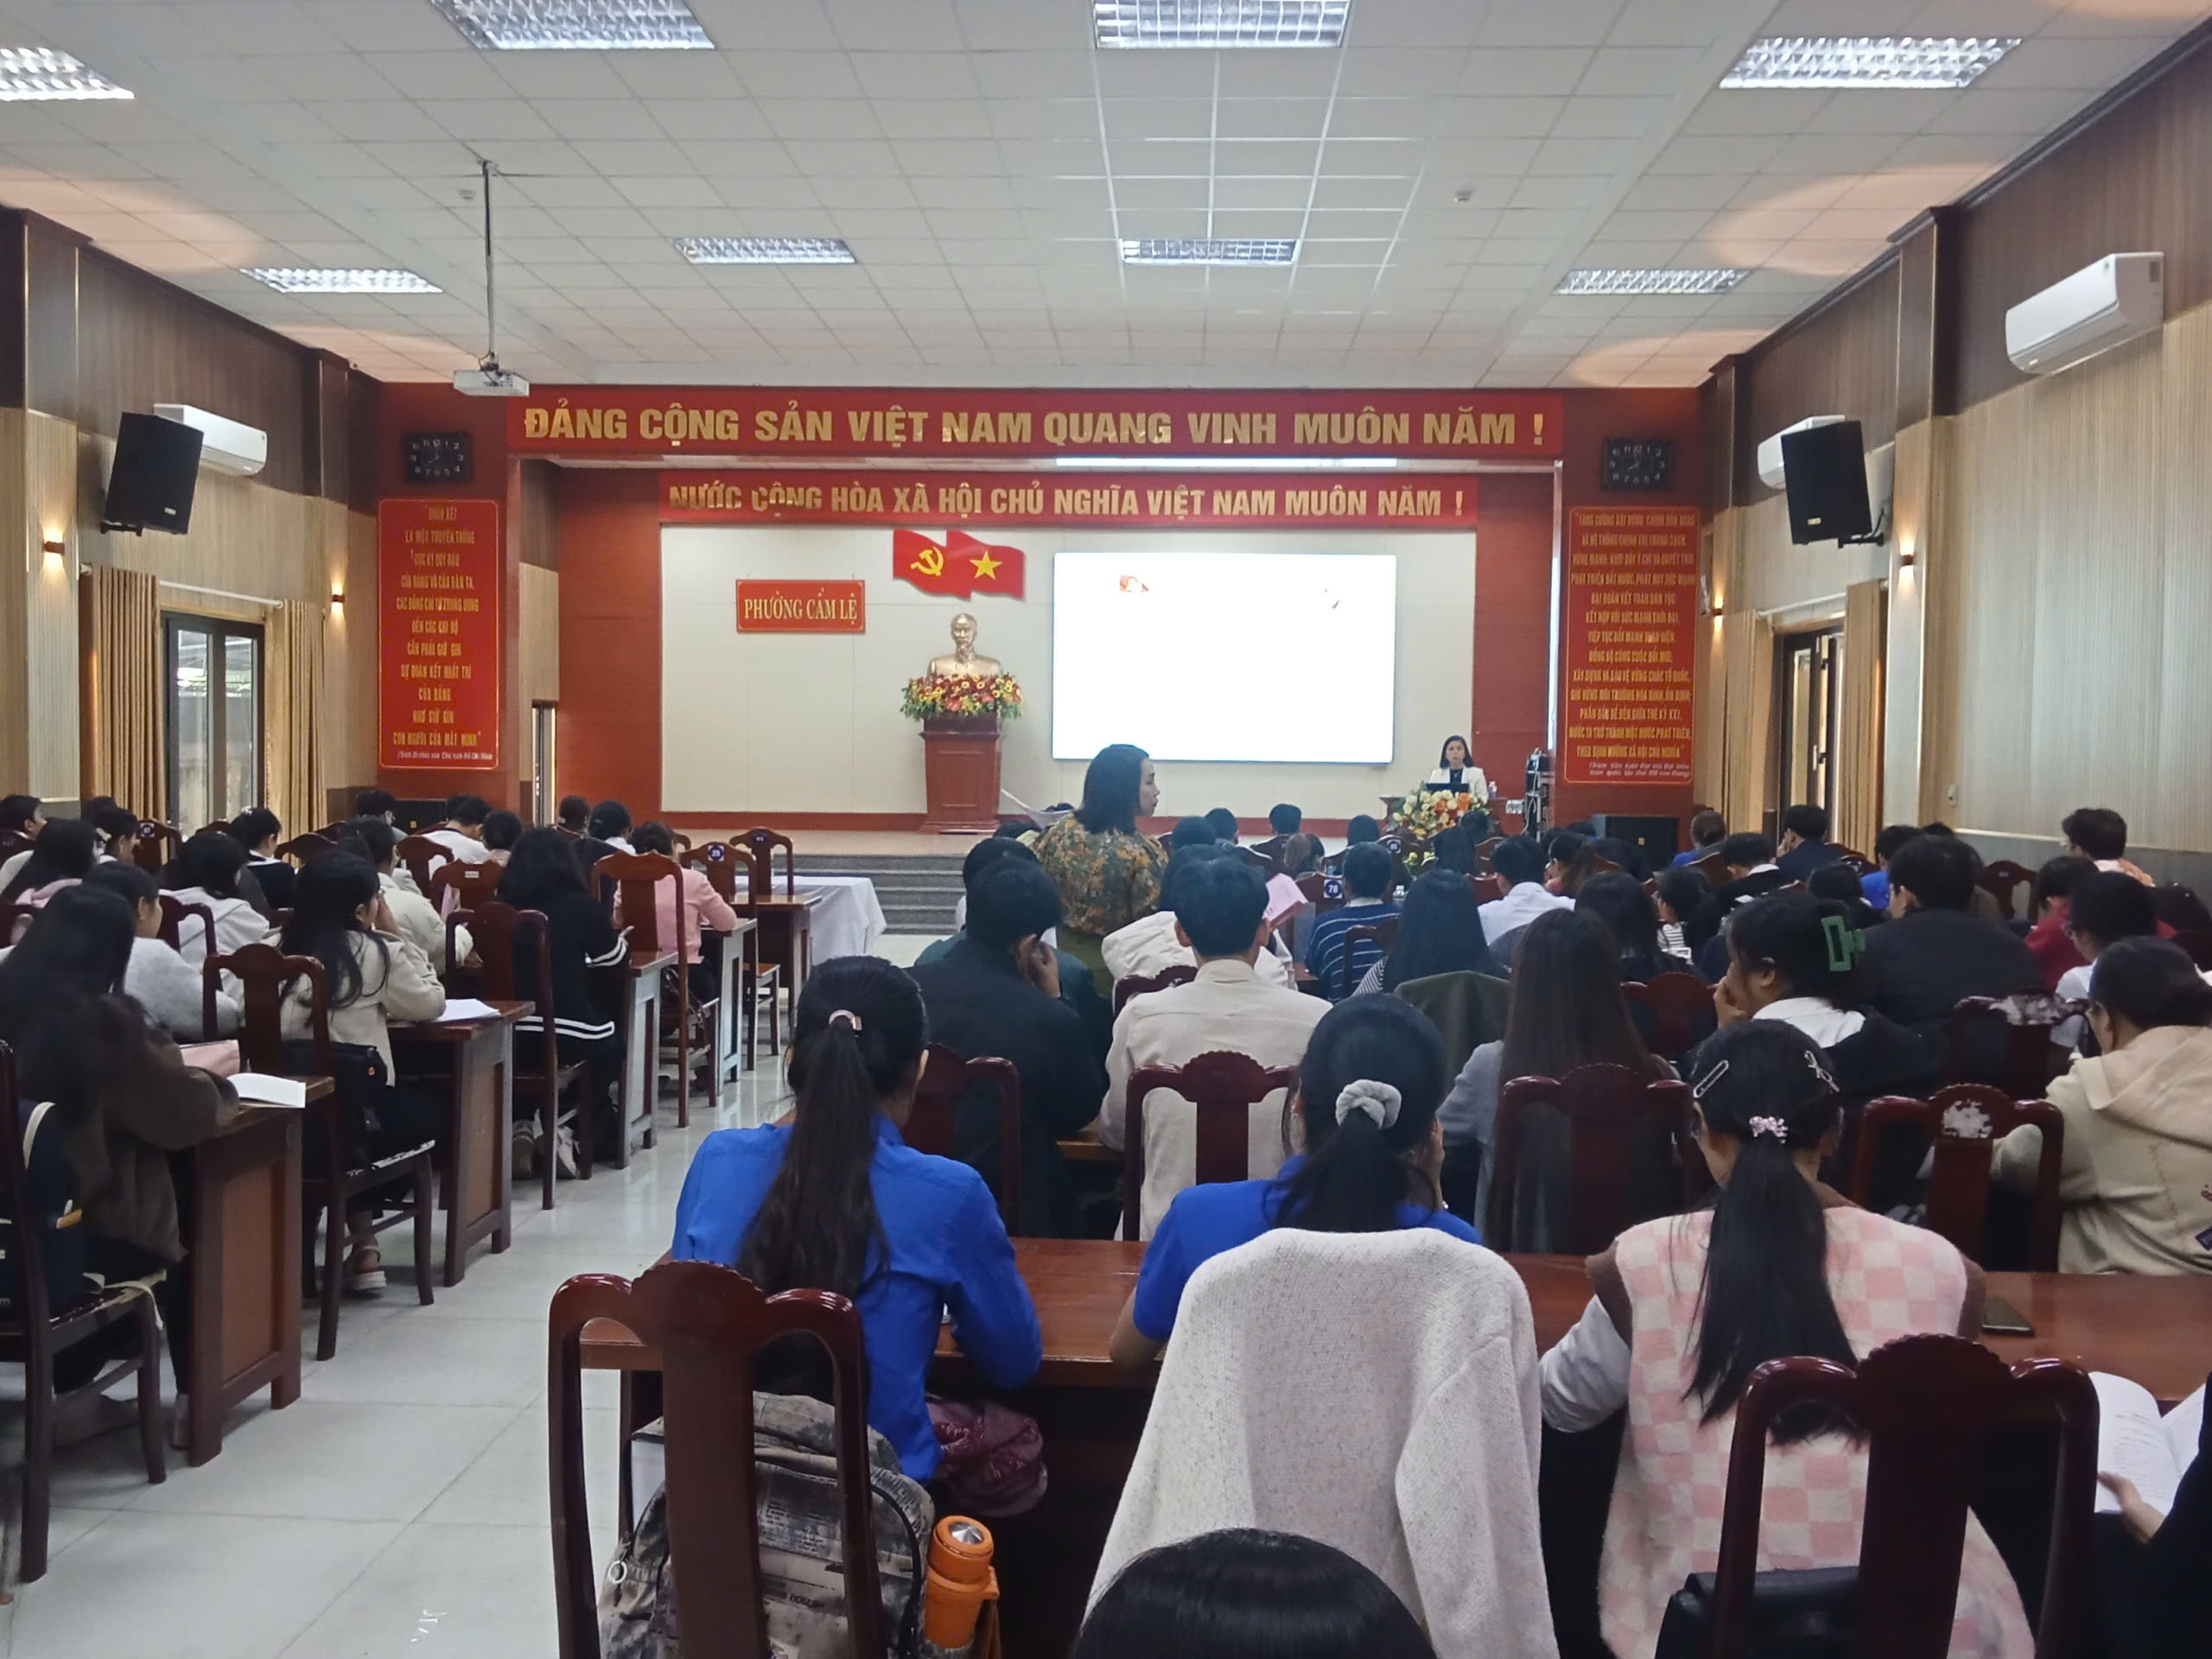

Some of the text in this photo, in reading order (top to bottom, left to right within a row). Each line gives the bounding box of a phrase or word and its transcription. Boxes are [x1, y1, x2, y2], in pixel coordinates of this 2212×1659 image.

[524, 397, 627, 439] ĐẢNG
[640, 403, 739, 447] CỘNG
[755, 400, 832, 442] SẢN
[849, 405, 929, 448] VIỆT
[942, 412, 1032, 443] NAM
[1043, 412, 1172, 446] QUANG
[1187, 413, 1277, 445] VINH
[1294, 405, 1410, 445] MUÔN
[1423, 406, 1516, 444] NĂM
[752, 482, 822, 517] CỘNG
[831, 481, 884, 512] HÒA
[893, 482, 931, 513] XÃ
[939, 482, 982, 519] HỘI
[991, 480, 1045, 514] CHỦ
[1054, 484, 1139, 516] NGHĨA
[1147, 484, 1205, 520] VIỆT
[1213, 490, 1276, 517] NAM
[1285, 484, 1368, 517] MUÔN
[1378, 485, 1441, 517] NĂM
[744, 587, 858, 625] PHƯỜNG CẨM LỆ
